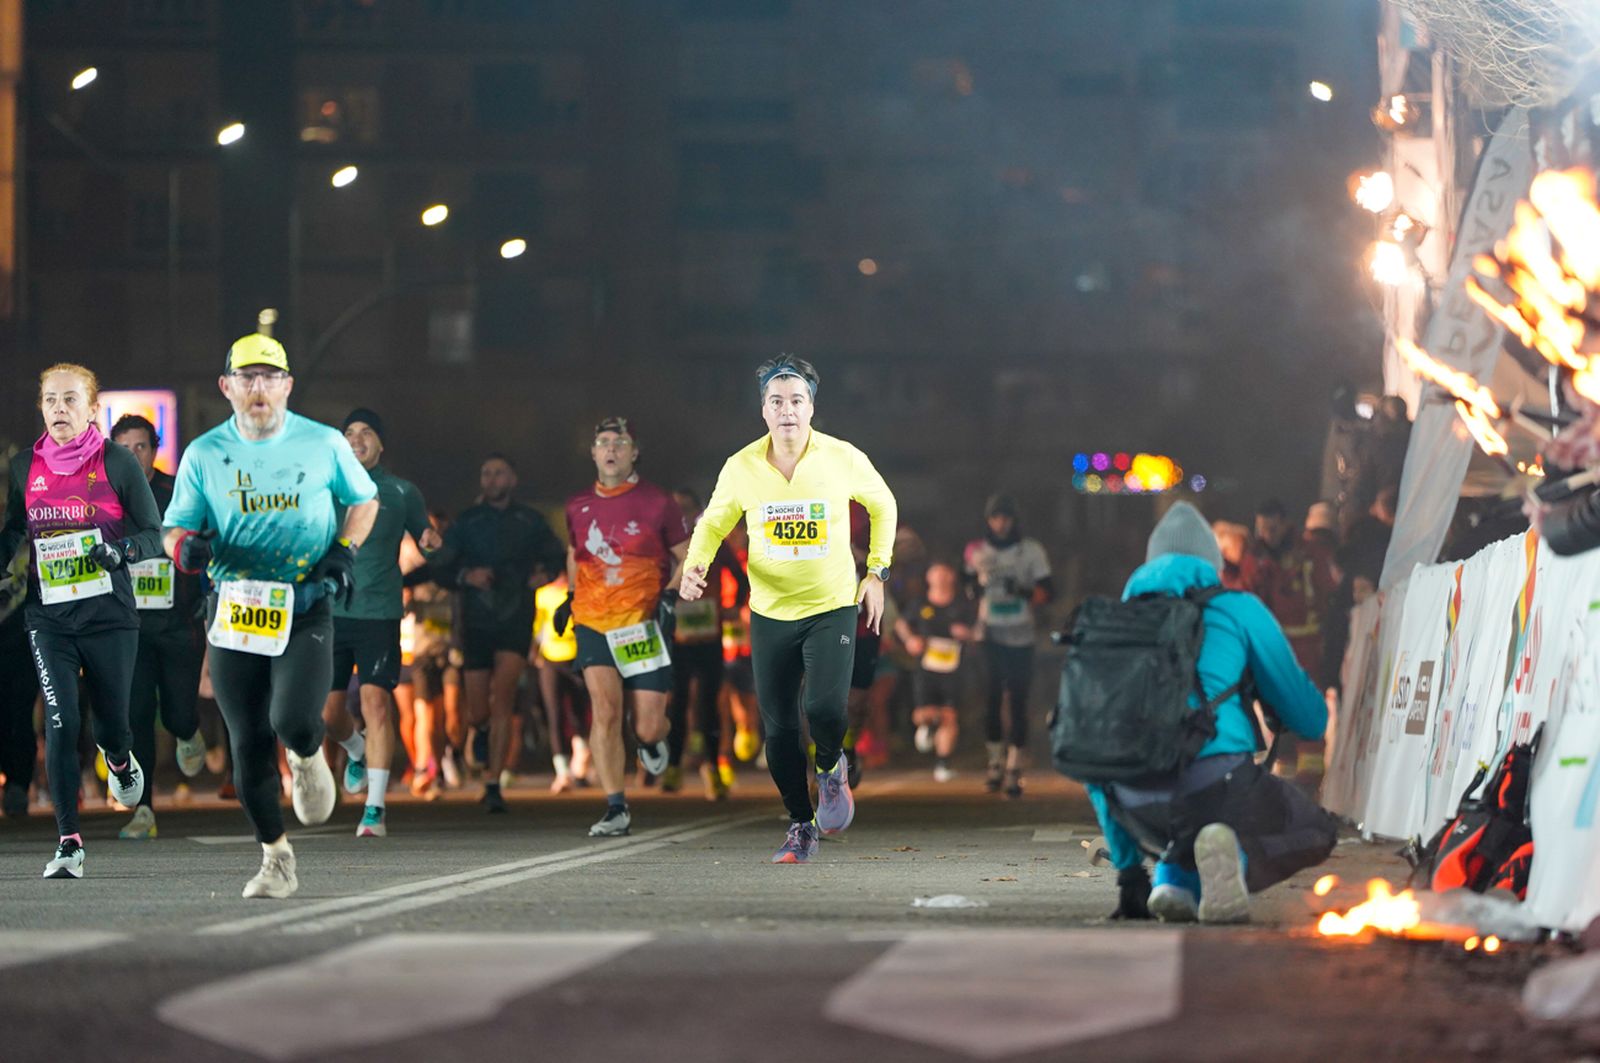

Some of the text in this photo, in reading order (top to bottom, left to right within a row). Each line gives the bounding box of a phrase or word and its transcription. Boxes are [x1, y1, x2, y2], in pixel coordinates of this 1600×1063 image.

[28, 504, 96, 522] SOBERBIO
[773, 521, 818, 540] 4526
[46, 555, 97, 580] 12678
[230, 603, 282, 630] 3009
[624, 638, 655, 658] 1422
[52, 712, 63, 729] LA
